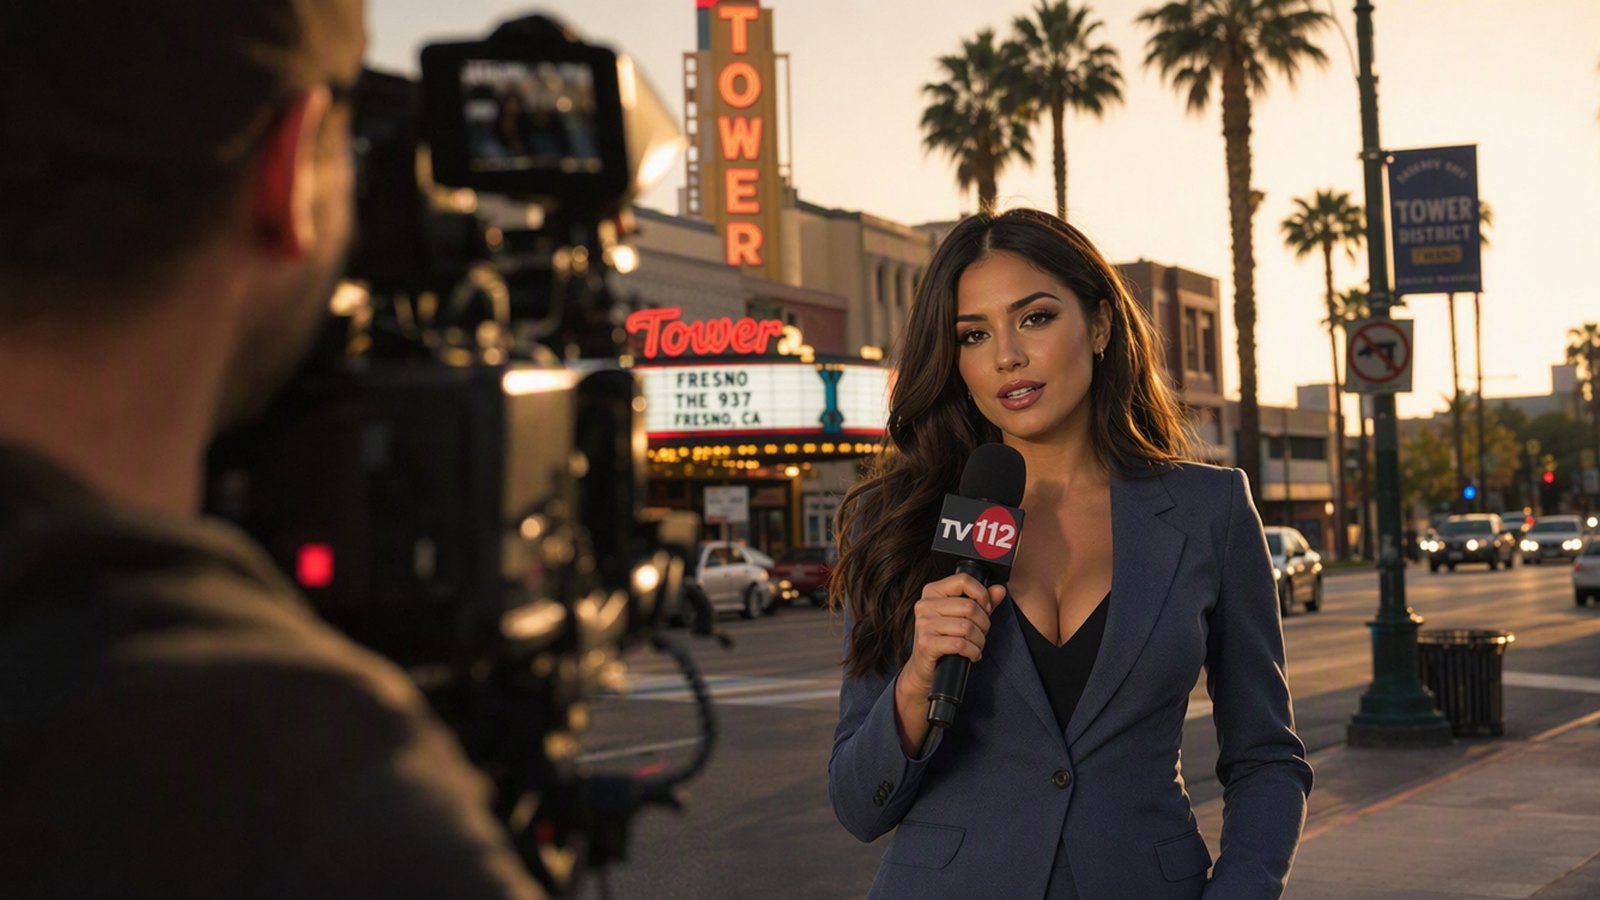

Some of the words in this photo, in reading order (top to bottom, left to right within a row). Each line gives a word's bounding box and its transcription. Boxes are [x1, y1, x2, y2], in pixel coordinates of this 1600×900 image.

[718, 5, 763, 266] TOWER
[1395, 197, 1473, 224] TOWER
[1399, 225, 1472, 244] DISTRICT
[626, 306, 783, 358] Tower
[676, 371, 748, 387] FRESNO
[675, 393, 708, 408] THE
[718, 392, 752, 407] 937
[674, 412, 736, 427] FRESNO,
[741, 412, 761, 425] CA
